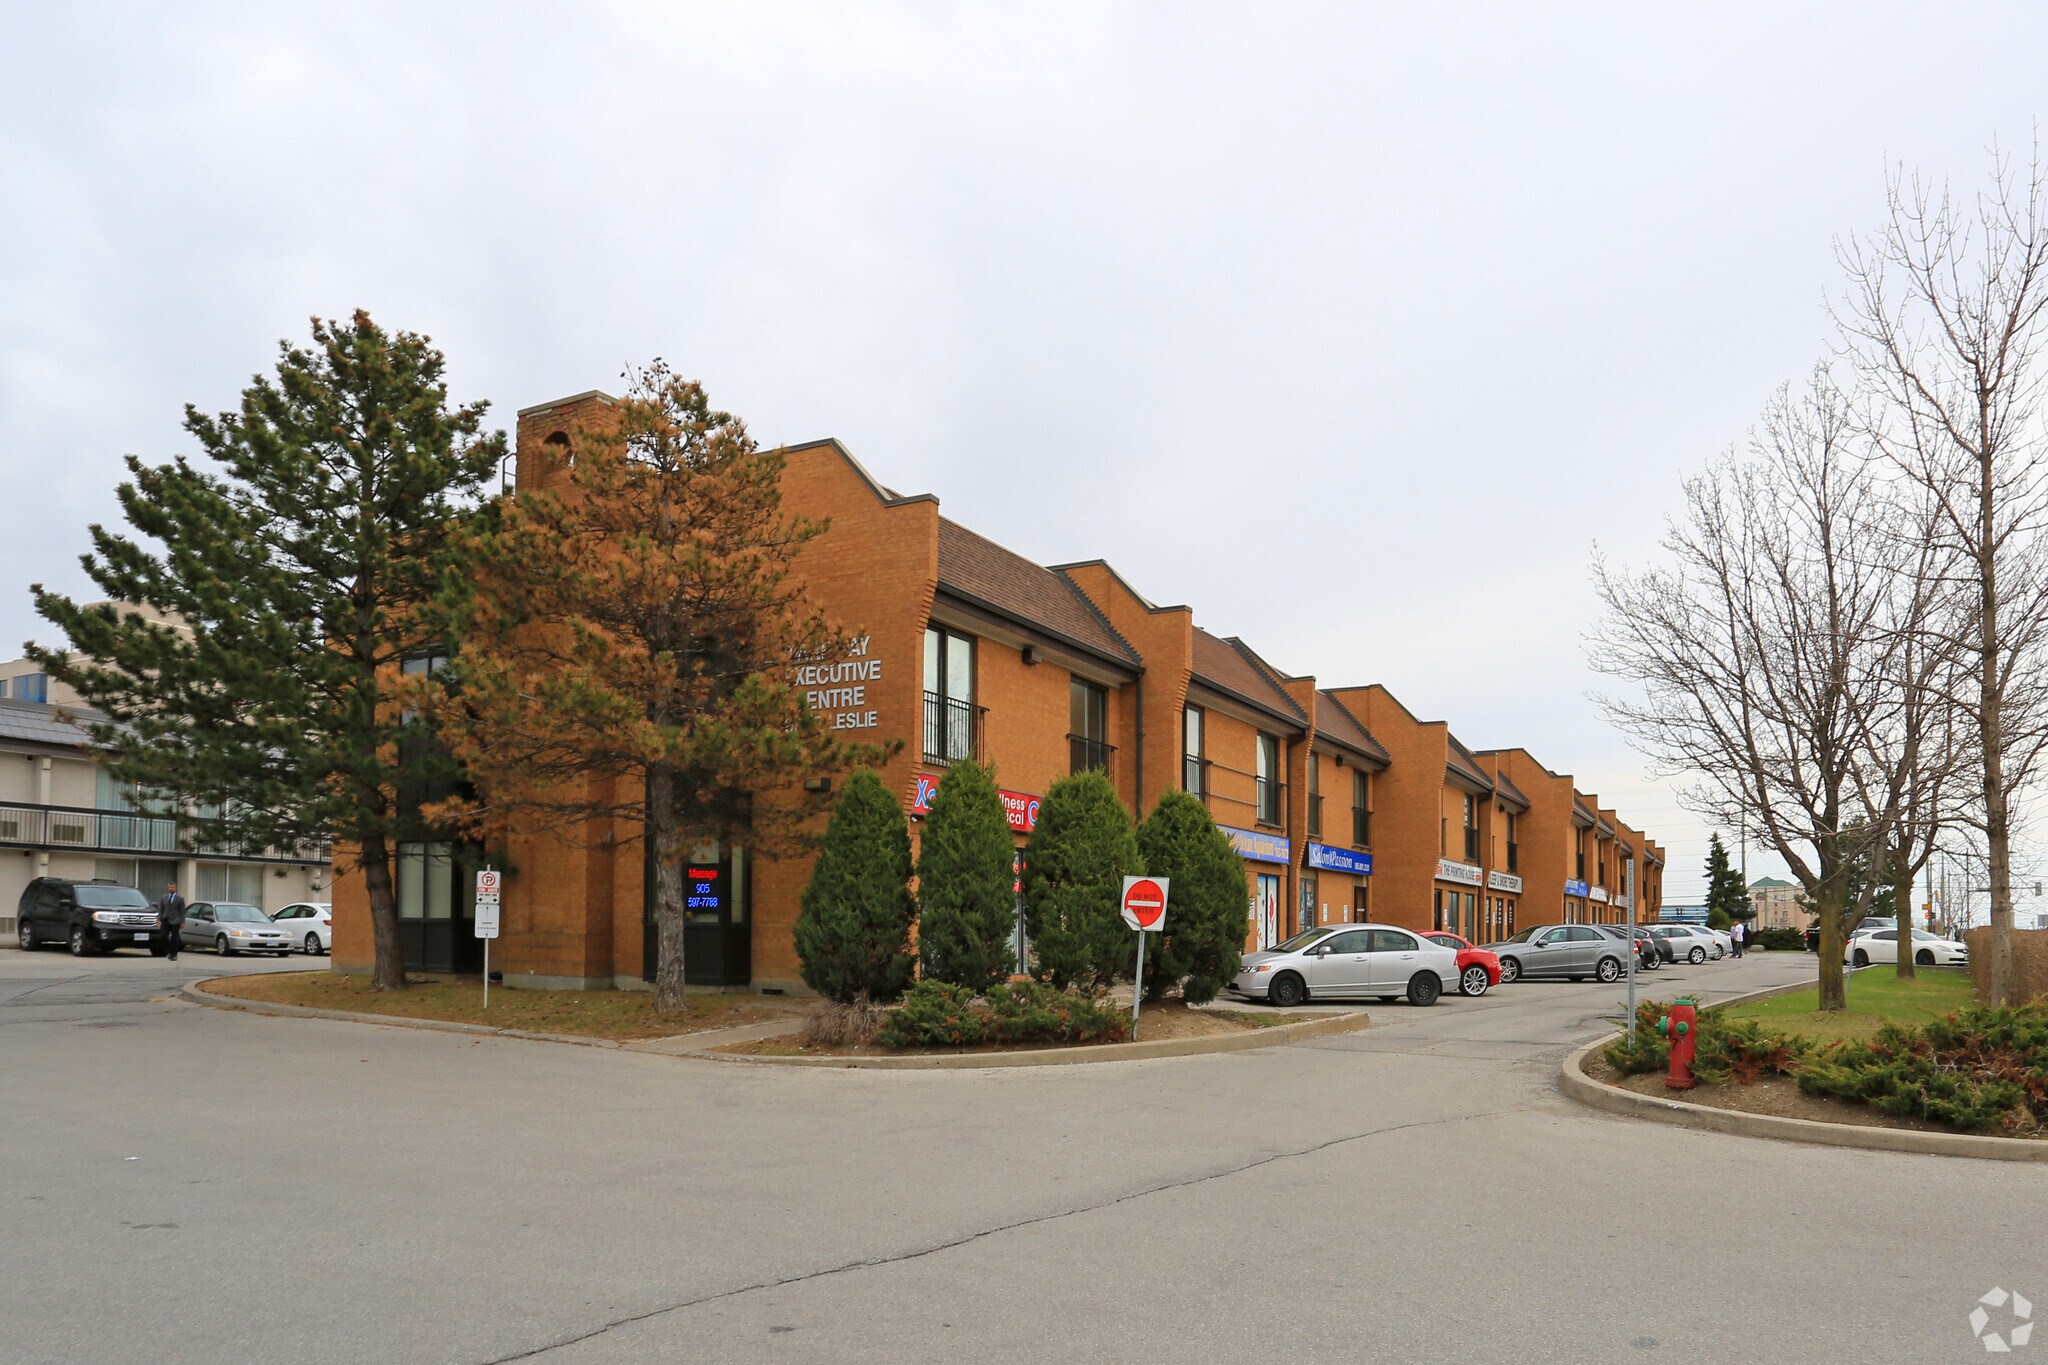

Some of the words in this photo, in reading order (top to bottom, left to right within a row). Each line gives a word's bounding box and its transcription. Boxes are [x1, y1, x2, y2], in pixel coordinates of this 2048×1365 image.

[785, 659, 882, 687] XECUTIVE
[807, 685, 865, 710] ENTRE
[1311, 846, 1330, 865] Salon
[696, 883, 710, 894] 905
